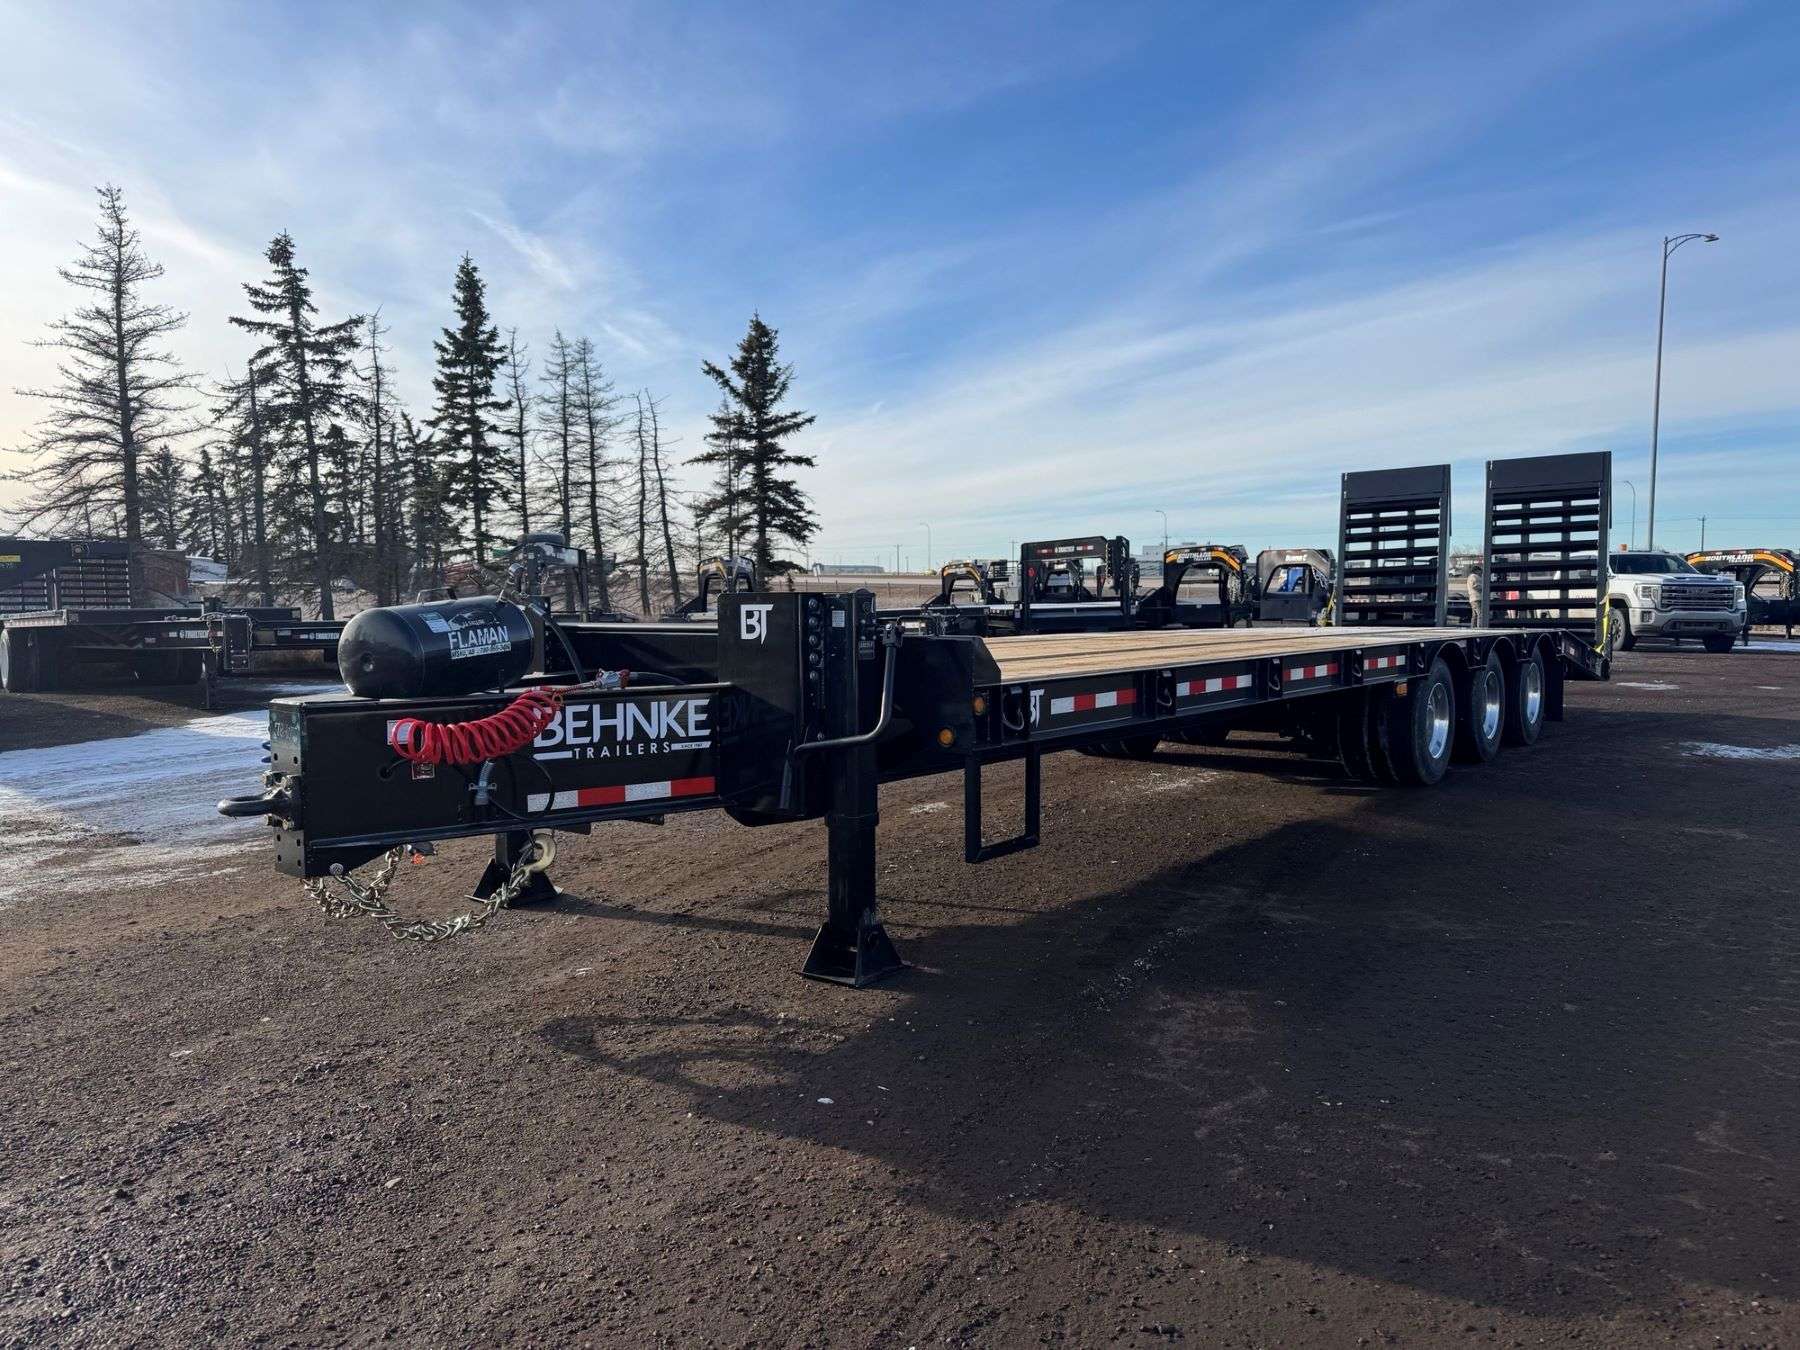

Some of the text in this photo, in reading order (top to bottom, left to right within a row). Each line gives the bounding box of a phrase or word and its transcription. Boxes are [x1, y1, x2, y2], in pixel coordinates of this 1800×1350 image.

[447, 625, 509, 650] FLAMAN
[740, 604, 774, 645] BT
[532, 698, 712, 748] BEHNKE
[574, 741, 672, 760] TRAILERS
